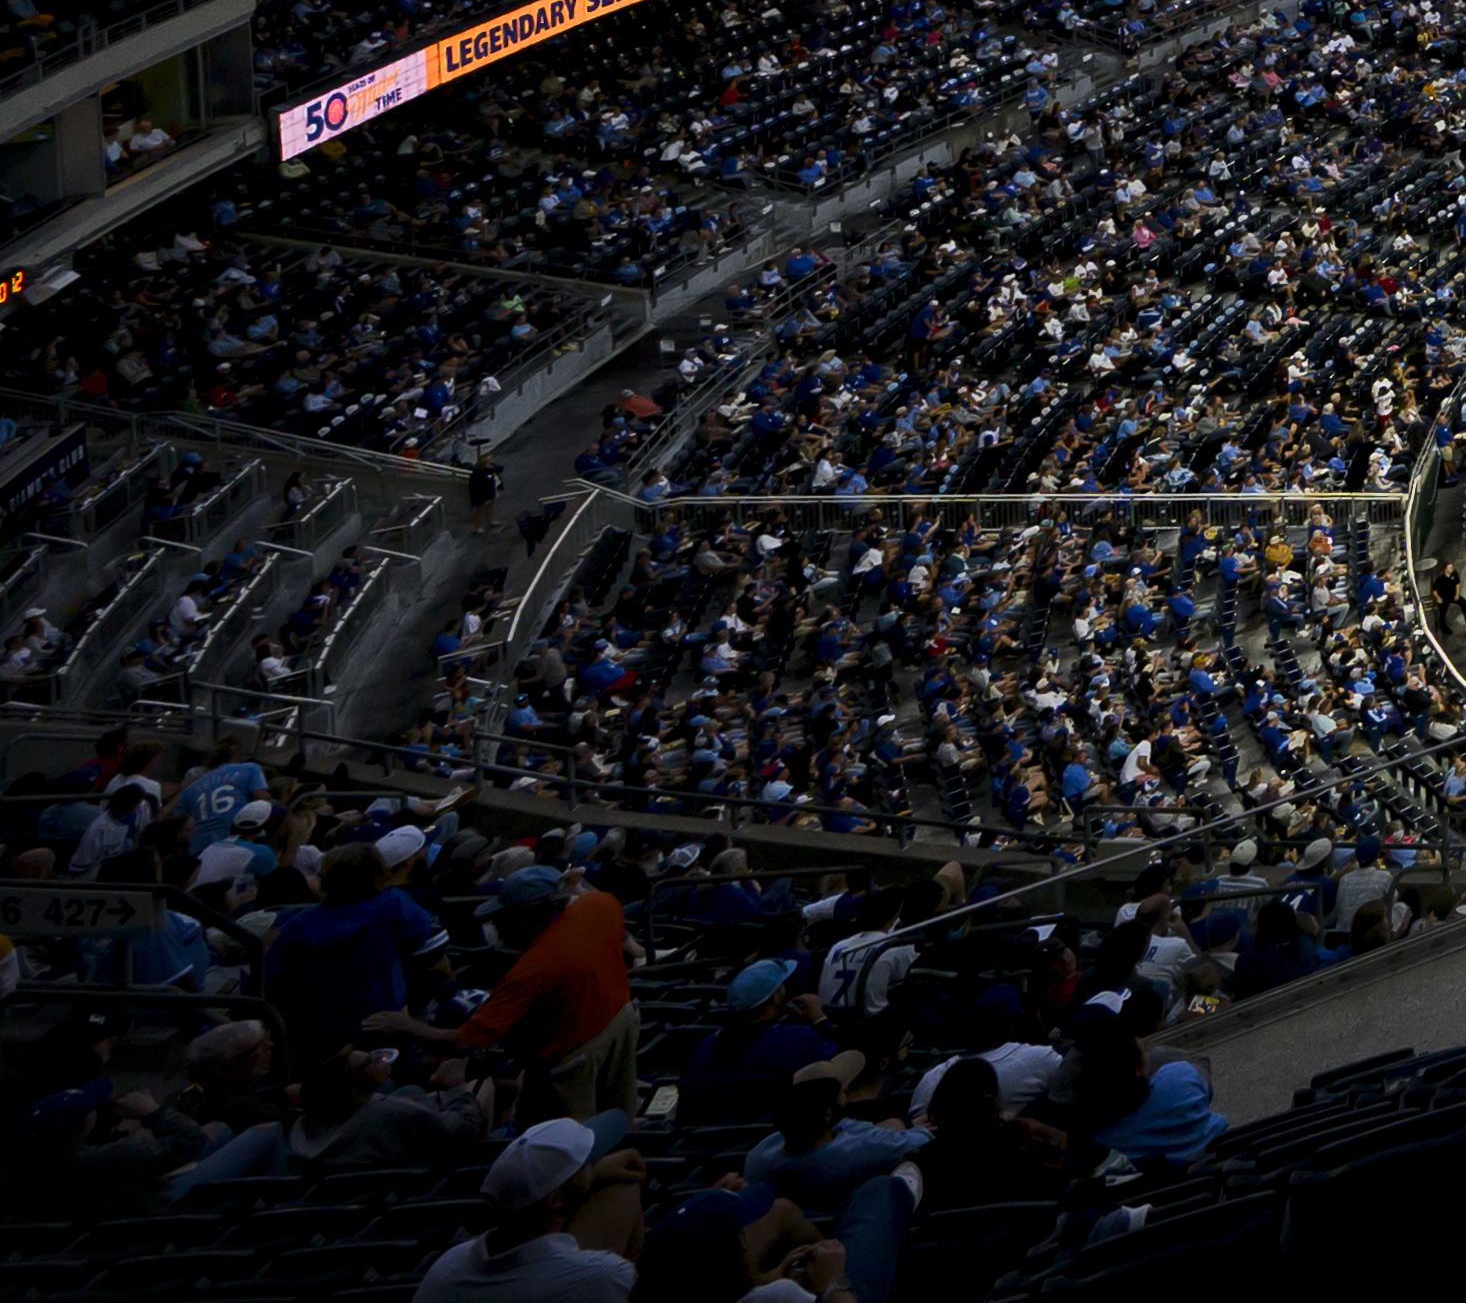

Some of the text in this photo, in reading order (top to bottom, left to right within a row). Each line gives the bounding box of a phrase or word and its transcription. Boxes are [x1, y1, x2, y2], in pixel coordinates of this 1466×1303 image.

[375, 88, 402, 112] TIME
[306, 92, 348, 142] 50
[197, 786, 234, 820] 16
[44, 898, 106, 926] 427
